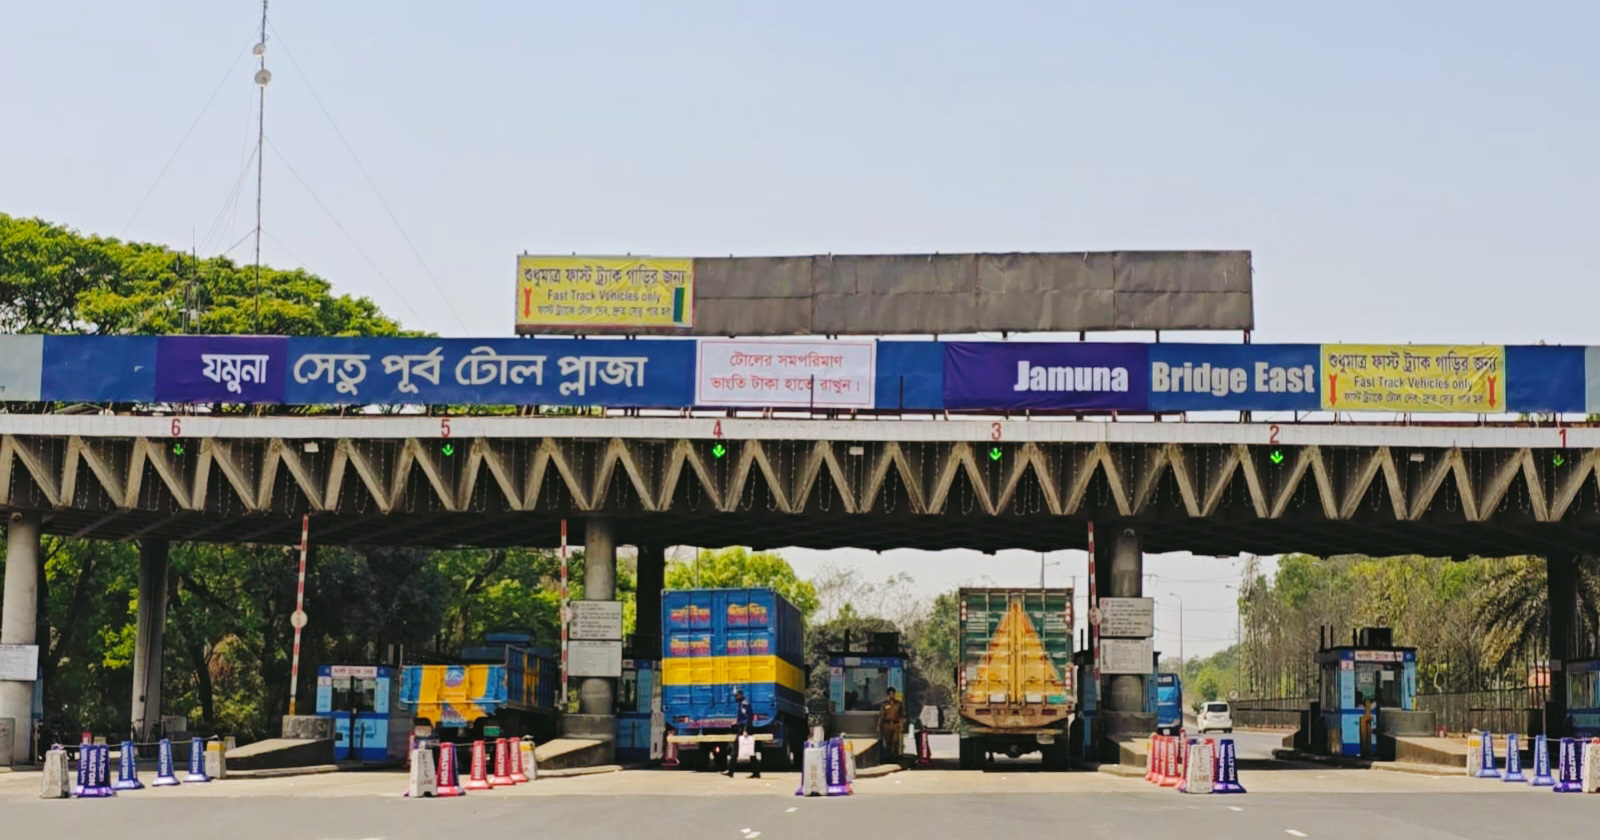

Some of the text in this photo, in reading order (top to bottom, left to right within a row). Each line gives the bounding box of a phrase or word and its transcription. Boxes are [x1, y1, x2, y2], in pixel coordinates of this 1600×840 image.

[524, 268, 561, 286] শুধুমাত্র
[566, 265, 592, 283] ফাস্ট
[627, 264, 658, 287] গাড়ির
[663, 269, 685, 284] জন্য
[548, 289, 662, 304] Fast Track Vehicles only
[730, 351, 843, 368] টোলের সমপরিমাণ
[1328, 354, 1367, 373] শুধুমাত্র
[1372, 350, 1400, 371] ফাস্ট
[1436, 351, 1469, 375] গাড়ির
[1473, 354, 1497, 372] জন্য
[201, 345, 648, 396] যমুনা সেতু পূর্ব টোল প্লাজা
[1013, 360, 1316, 397] Jamuna Bridge East
[711, 374, 747, 390] ভাংতি
[751, 374, 779, 390] টাকা
[784, 376, 814, 391] হাতে
[819, 378, 852, 394] রাখুন
[1354, 376, 1473, 394] Fast Track Vehicles only
[171, 418, 181, 437] 6
[441, 419, 451, 438] 5
[713, 420, 722, 438] 4
[991, 422, 1001, 440] 3
[1269, 425, 1280, 444] 2
[1559, 428, 1566, 448] 1
[88, 749, 97, 786] WALTON
[831, 747, 840, 785] WALTON
